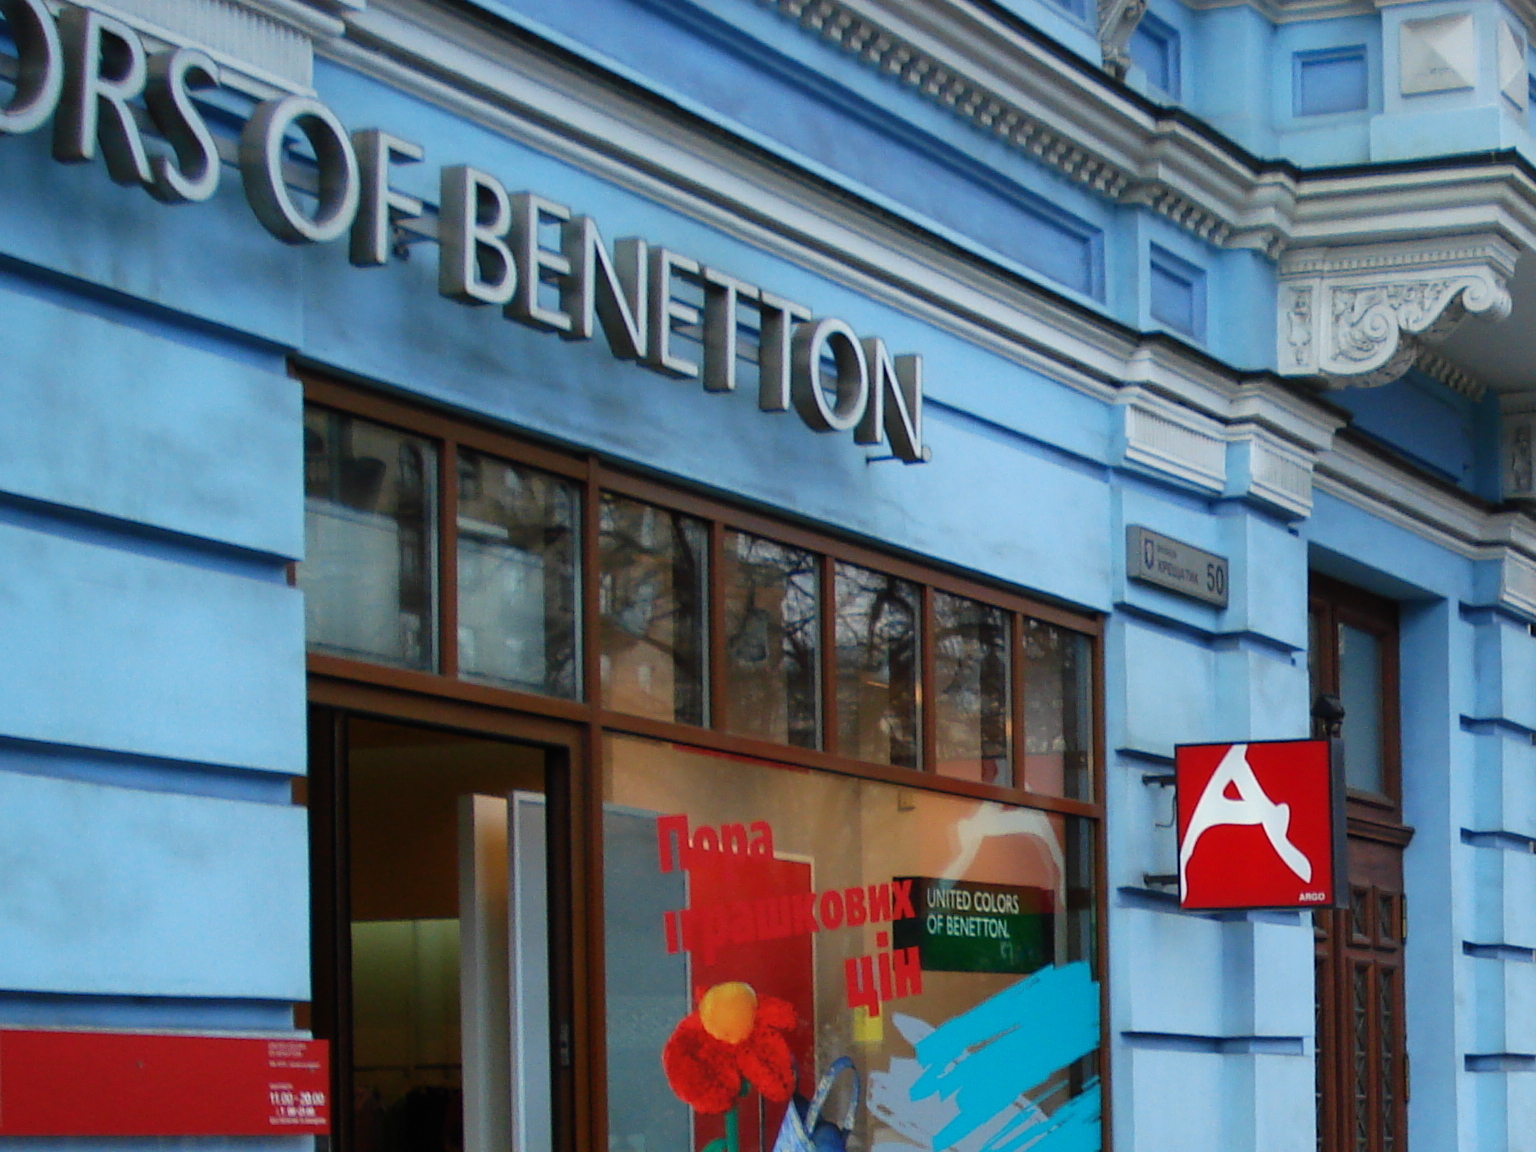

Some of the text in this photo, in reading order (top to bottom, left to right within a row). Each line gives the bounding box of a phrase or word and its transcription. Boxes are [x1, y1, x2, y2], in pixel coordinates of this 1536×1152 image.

[241, 95, 424, 266] OF
[1207, 562, 1224, 596] 50
[926, 887, 1020, 915] UNITED COLORS
[1298, 892, 1326, 902] ARGO
[926, 912, 944, 935] OF
